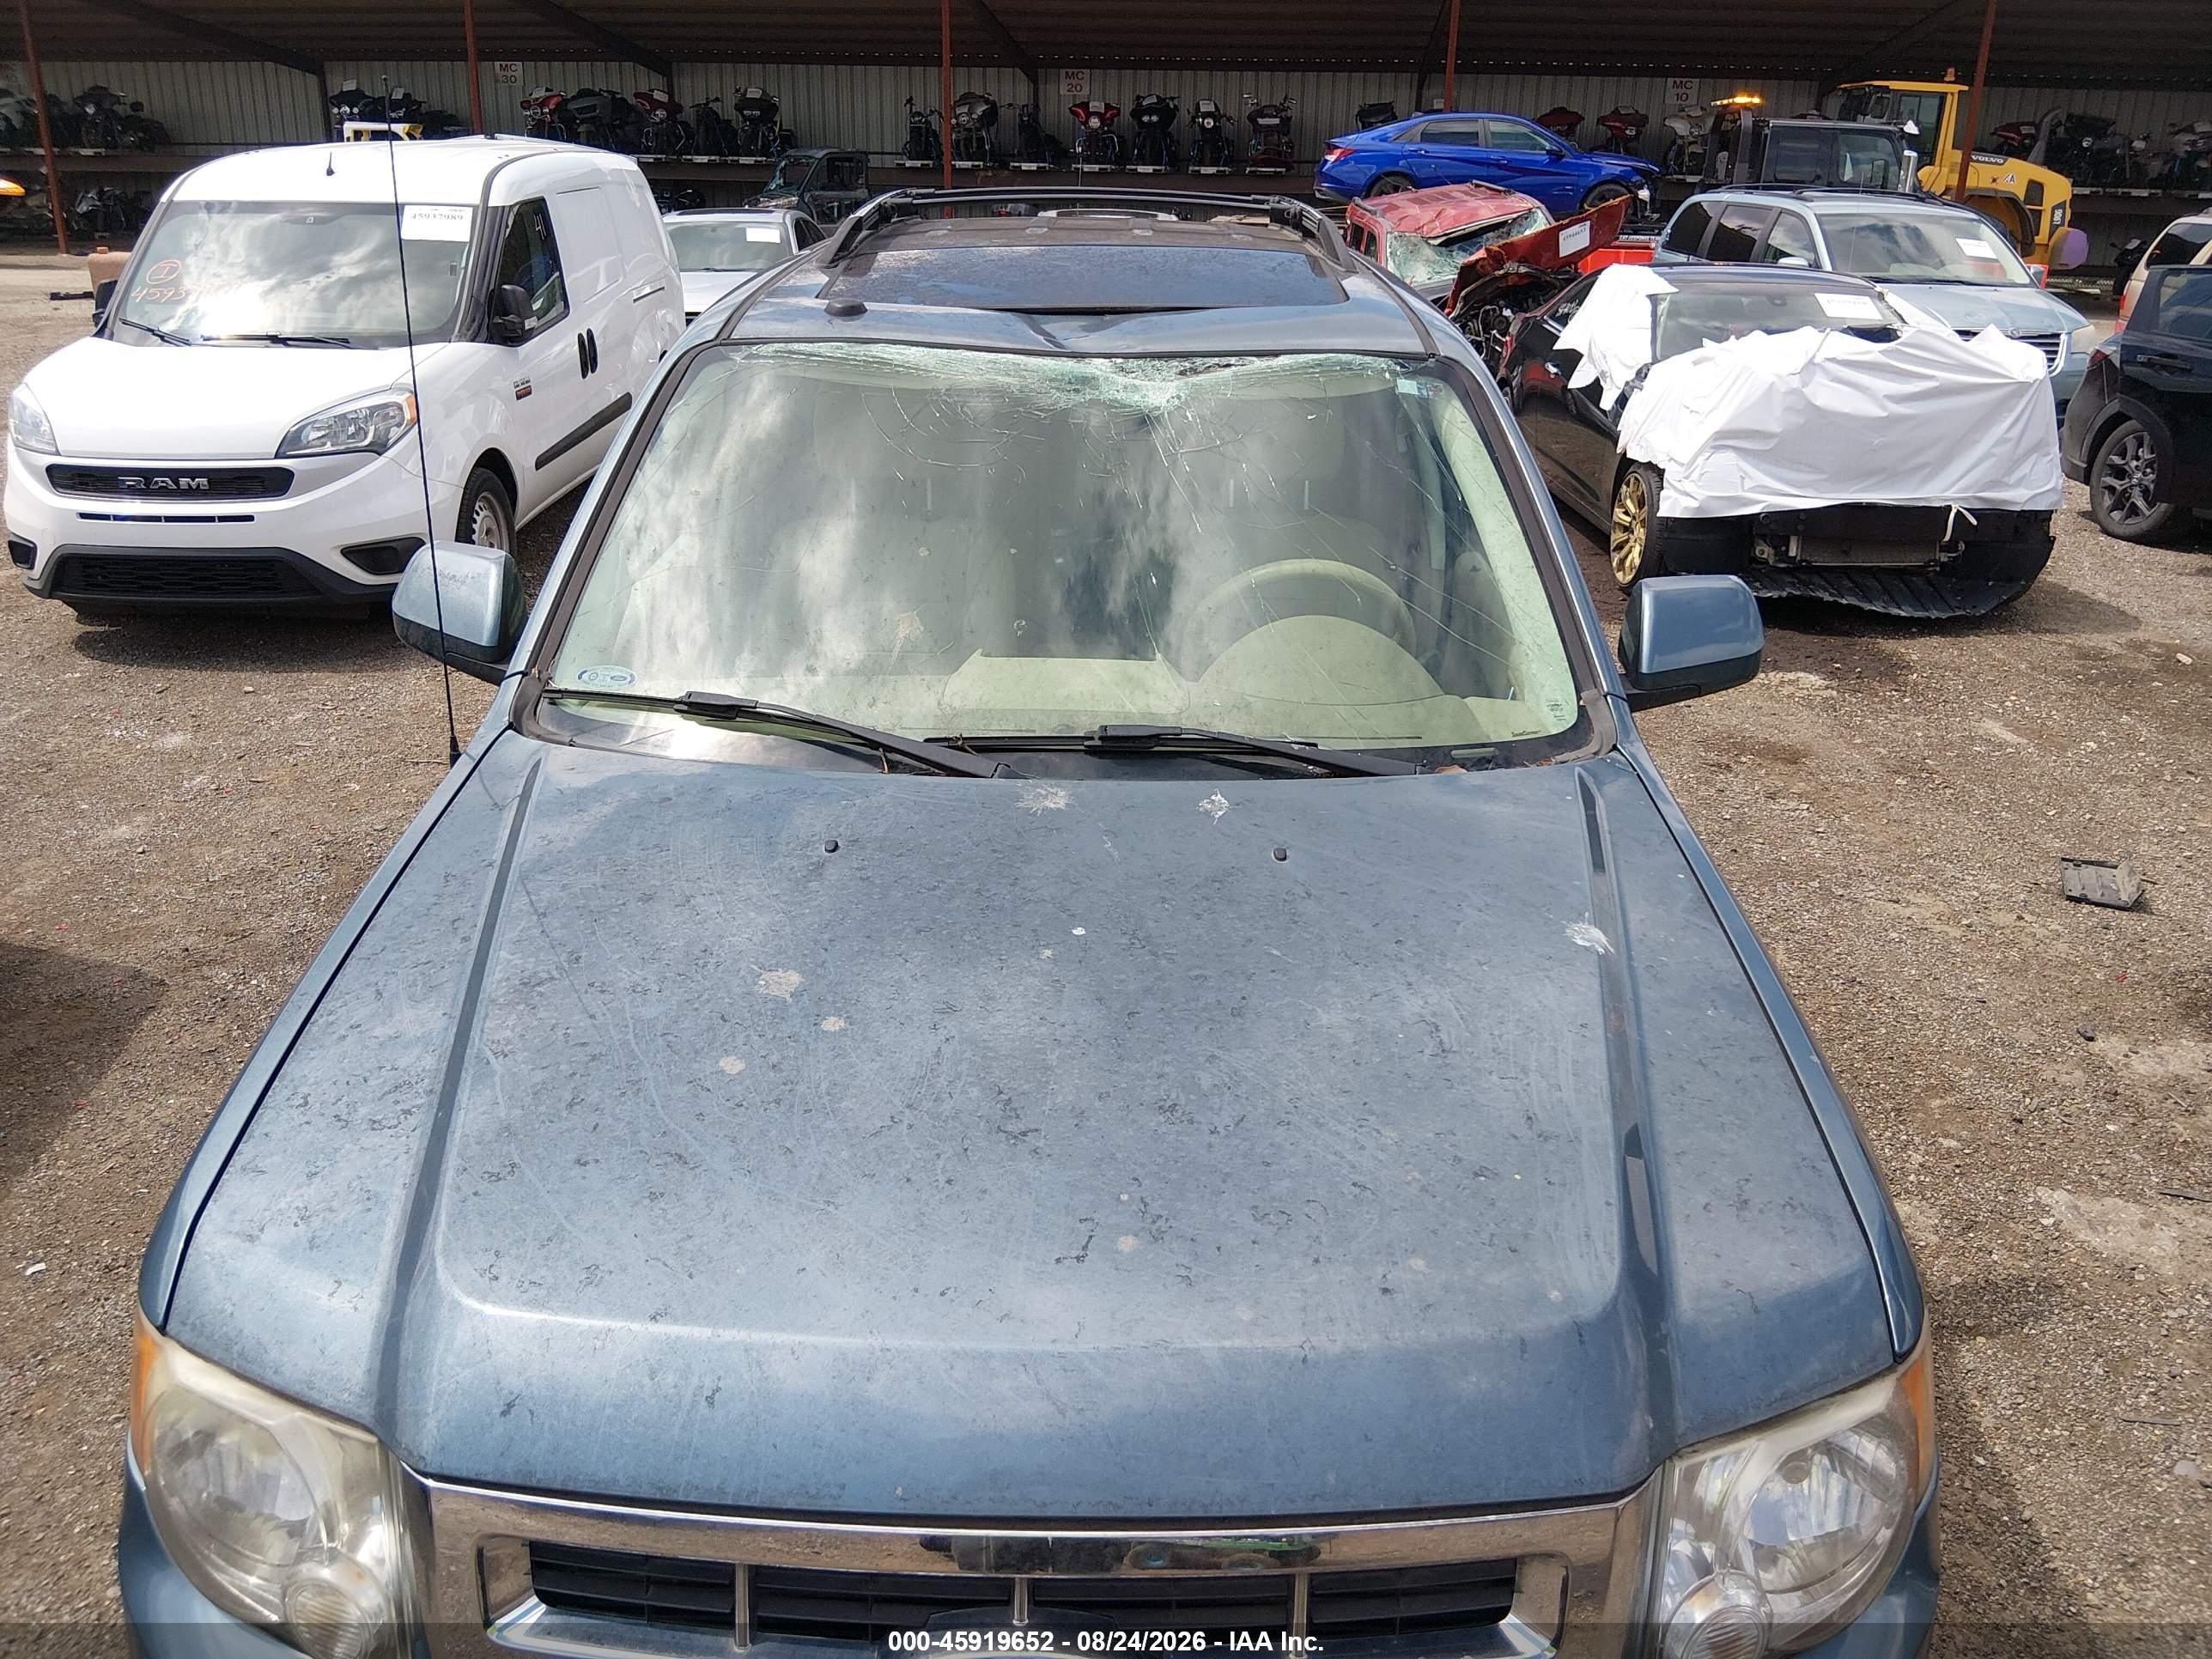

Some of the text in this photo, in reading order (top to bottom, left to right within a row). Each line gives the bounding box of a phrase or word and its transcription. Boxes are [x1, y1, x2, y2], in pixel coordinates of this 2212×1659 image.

[499, 63, 518, 72] MC
[501, 75, 517, 83] 30
[1065, 70, 1085, 81] MC
[1066, 82, 1083, 93] 20
[1672, 80, 1693, 89] MC
[1674, 92, 1689, 102] 10
[1971, 155, 2004, 164] VOLVO
[2052, 209, 2063, 225] L90G
[533, 213, 547, 240] 41
[117, 477, 210, 489] RAM
